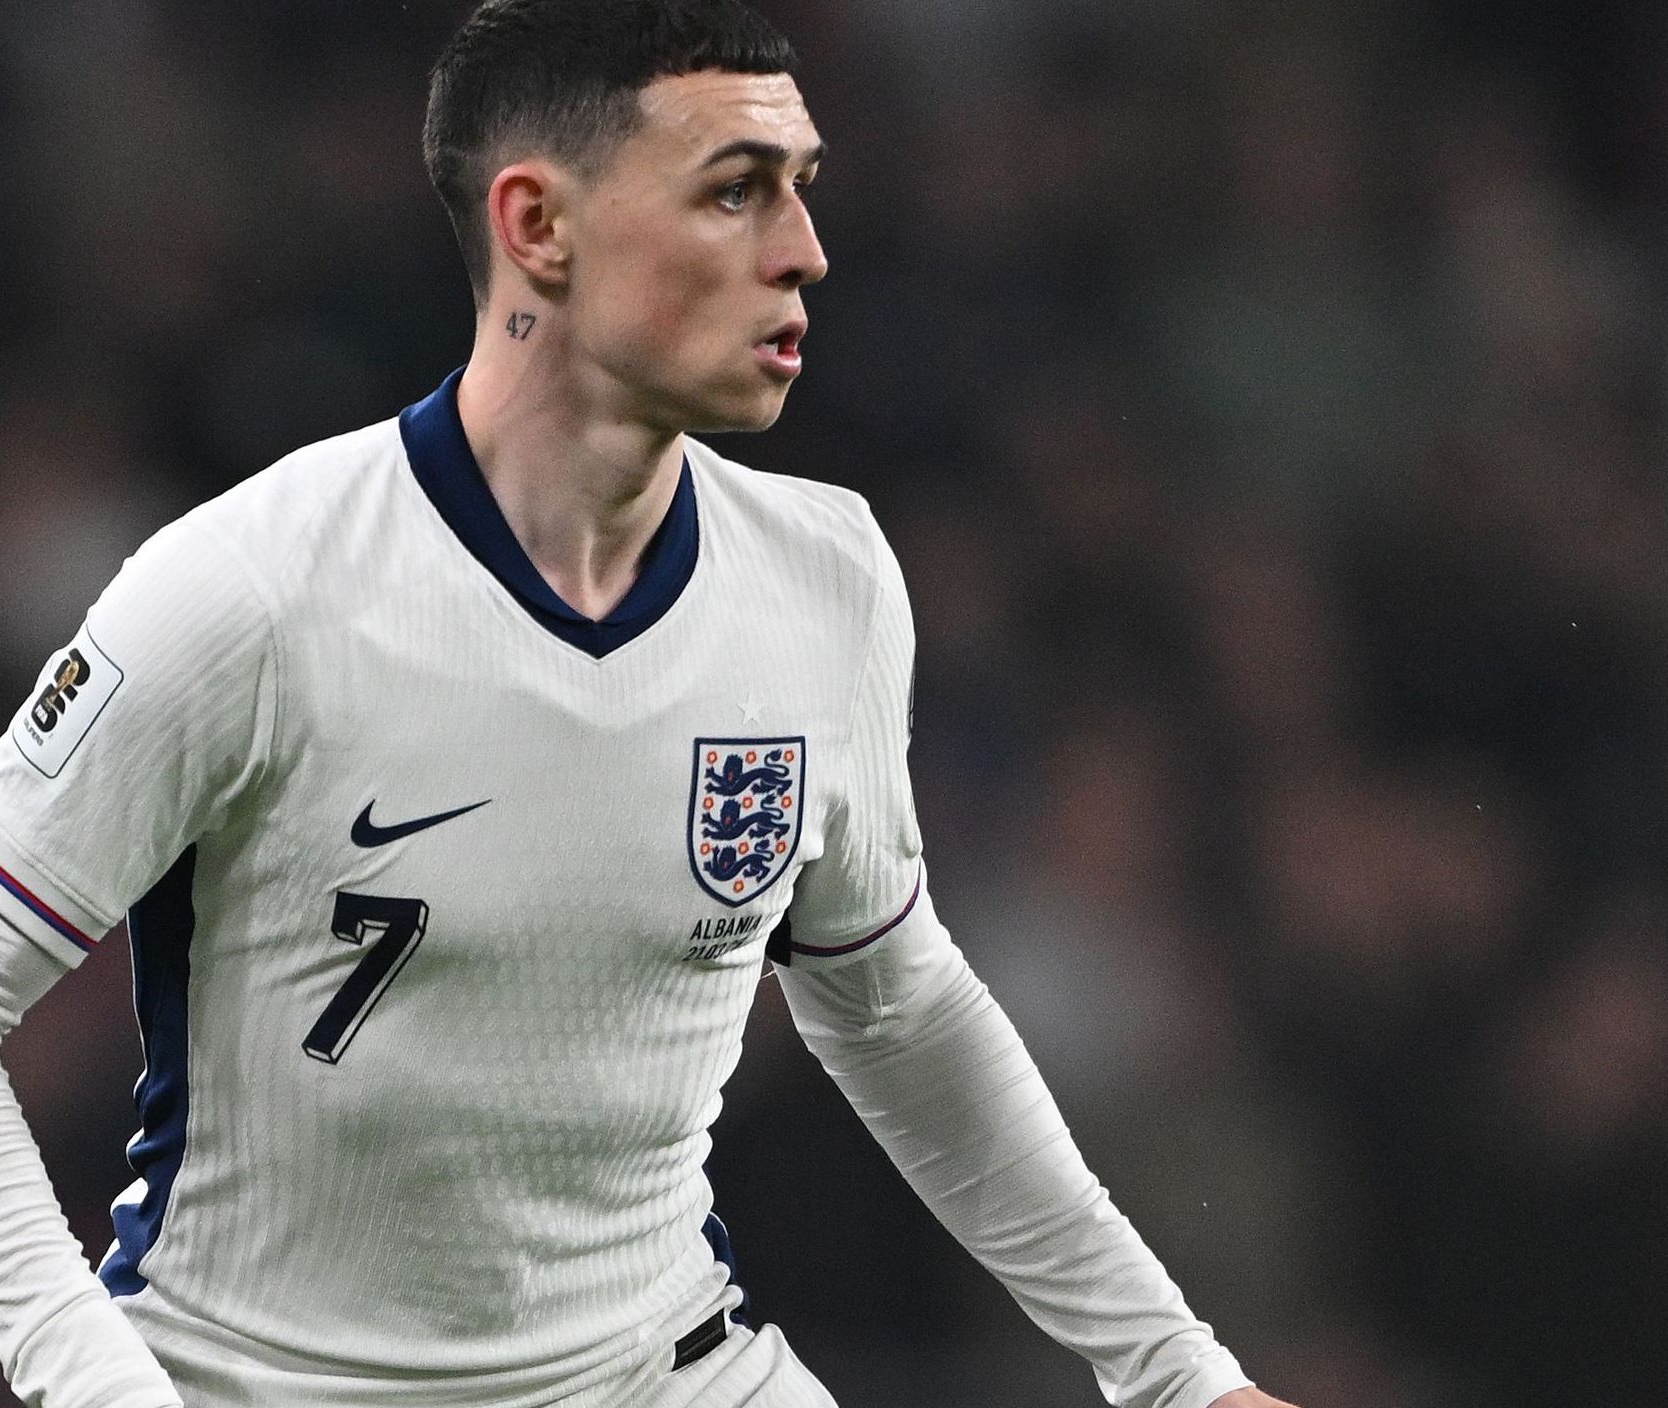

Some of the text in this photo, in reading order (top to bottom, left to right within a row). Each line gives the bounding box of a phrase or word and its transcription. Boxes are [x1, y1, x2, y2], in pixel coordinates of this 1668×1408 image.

[506, 311, 536, 340] 47
[689, 914, 763, 941] ALBANIA
[301, 890, 430, 1066] 7
